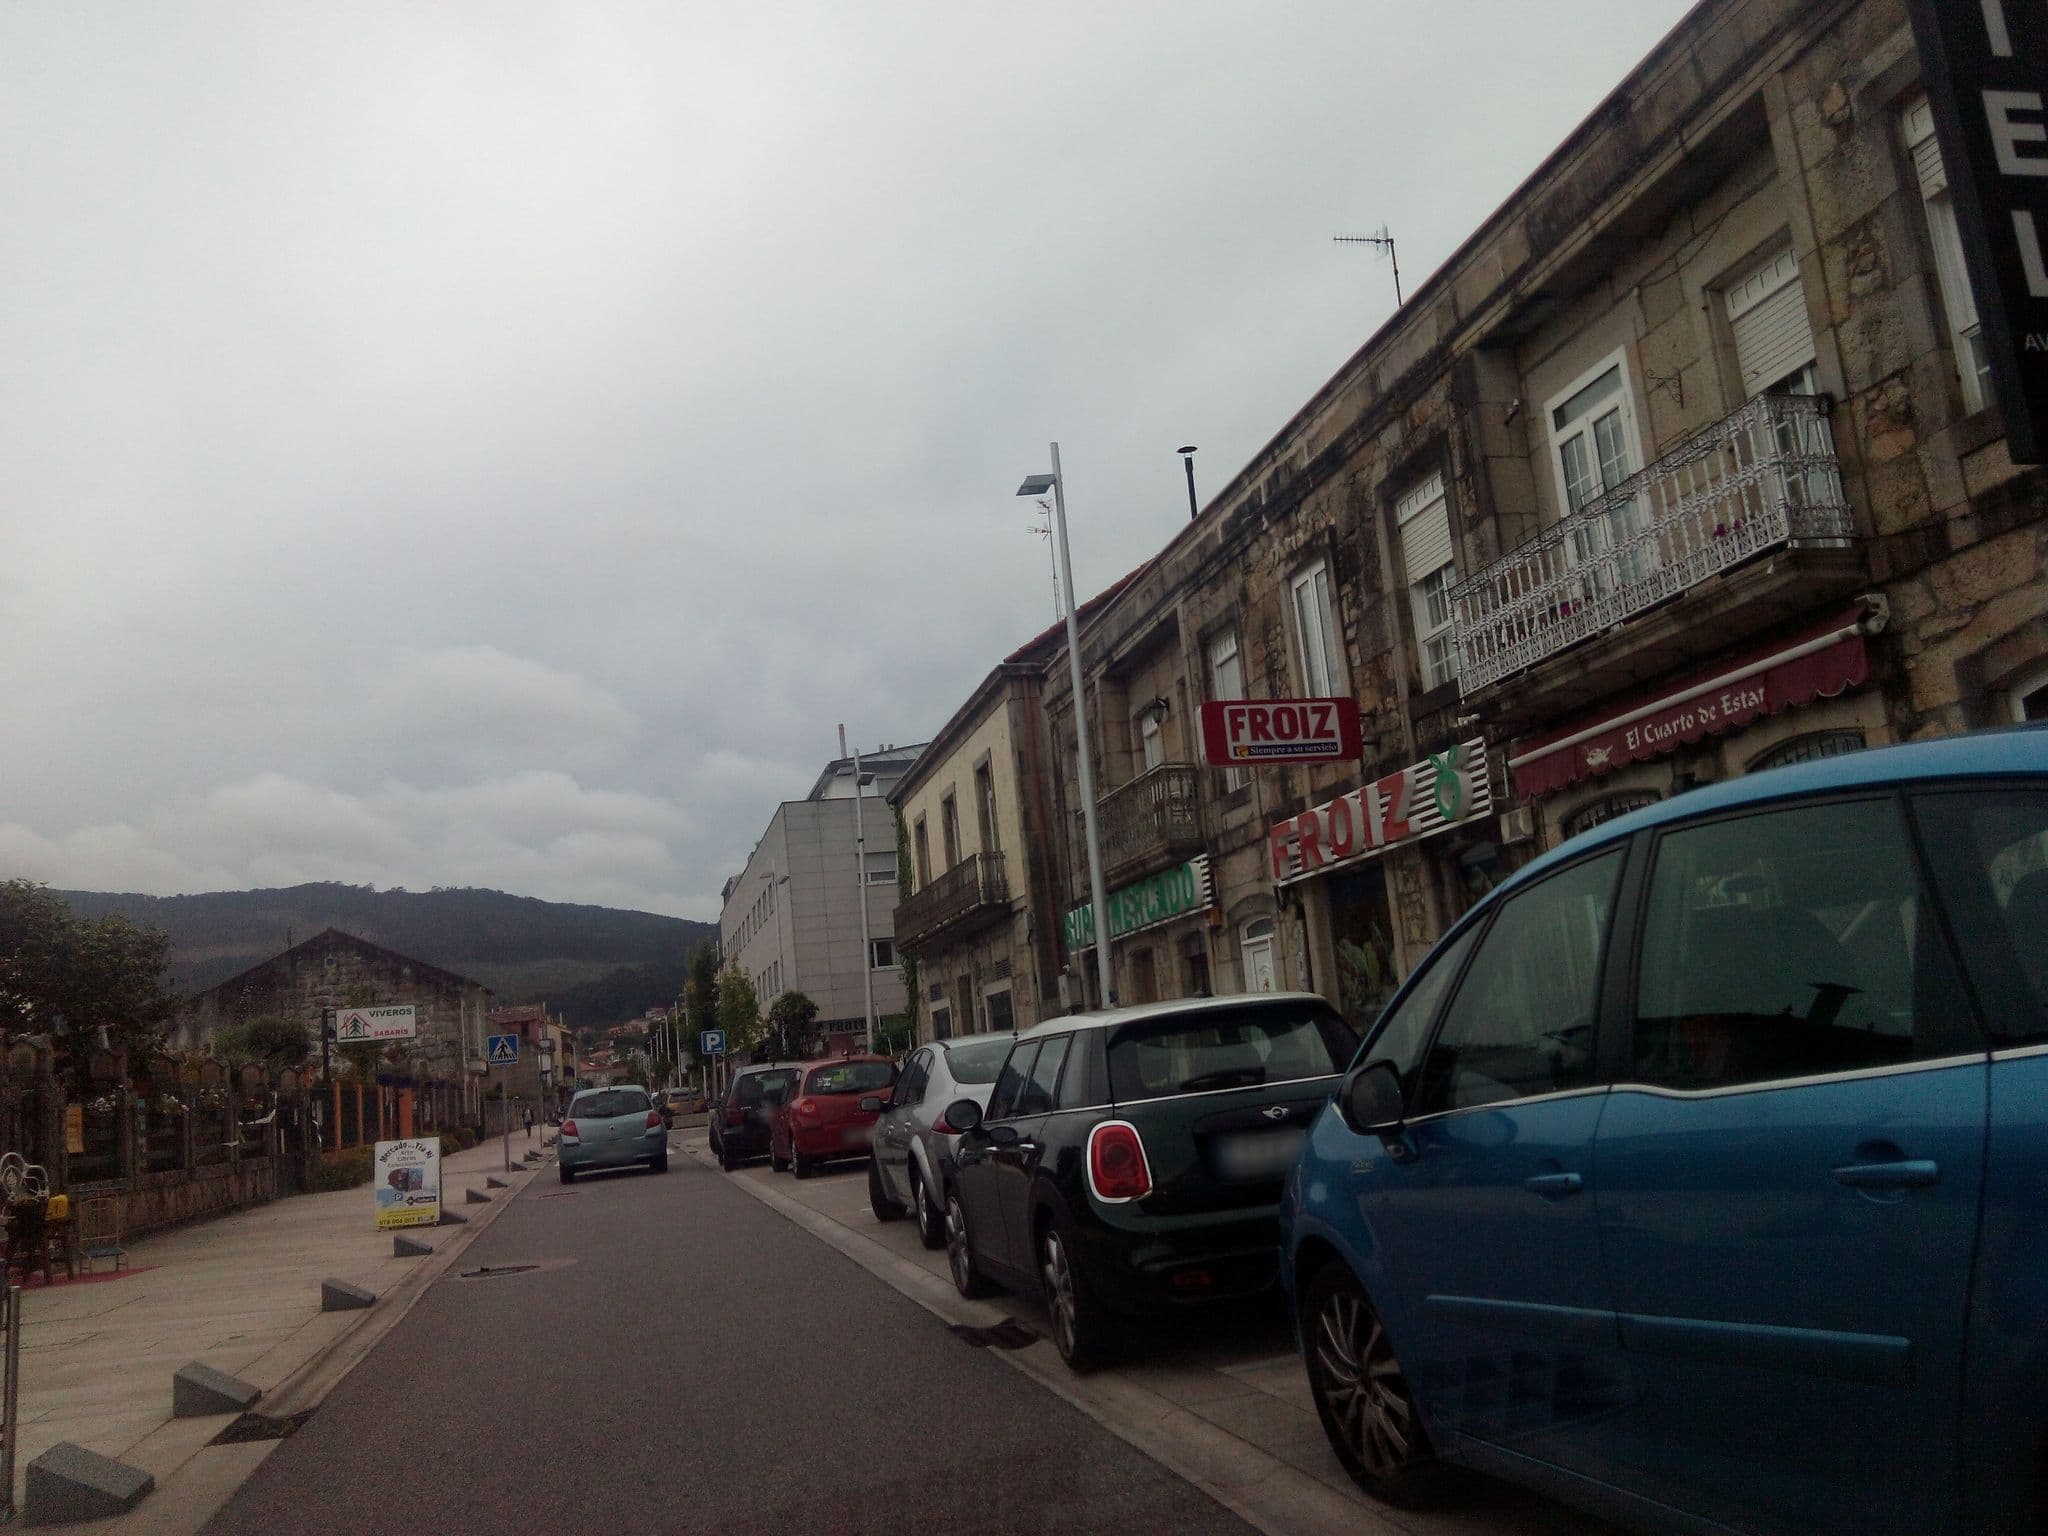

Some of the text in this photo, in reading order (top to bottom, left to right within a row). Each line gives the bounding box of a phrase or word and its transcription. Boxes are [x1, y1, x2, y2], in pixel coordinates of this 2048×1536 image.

[1228, 706, 1335, 742] FROIZ
[1625, 687, 1765, 750] El Cuarto de Estar
[1250, 744, 1286, 758] Siempre
[1306, 743, 1337, 752] servicio
[1270, 771, 1412, 880] FROIZ
[369, 1008, 412, 1018] VIVEROS
[706, 1033, 720, 1050] P
[379, 1141, 408, 1163] Mercado
